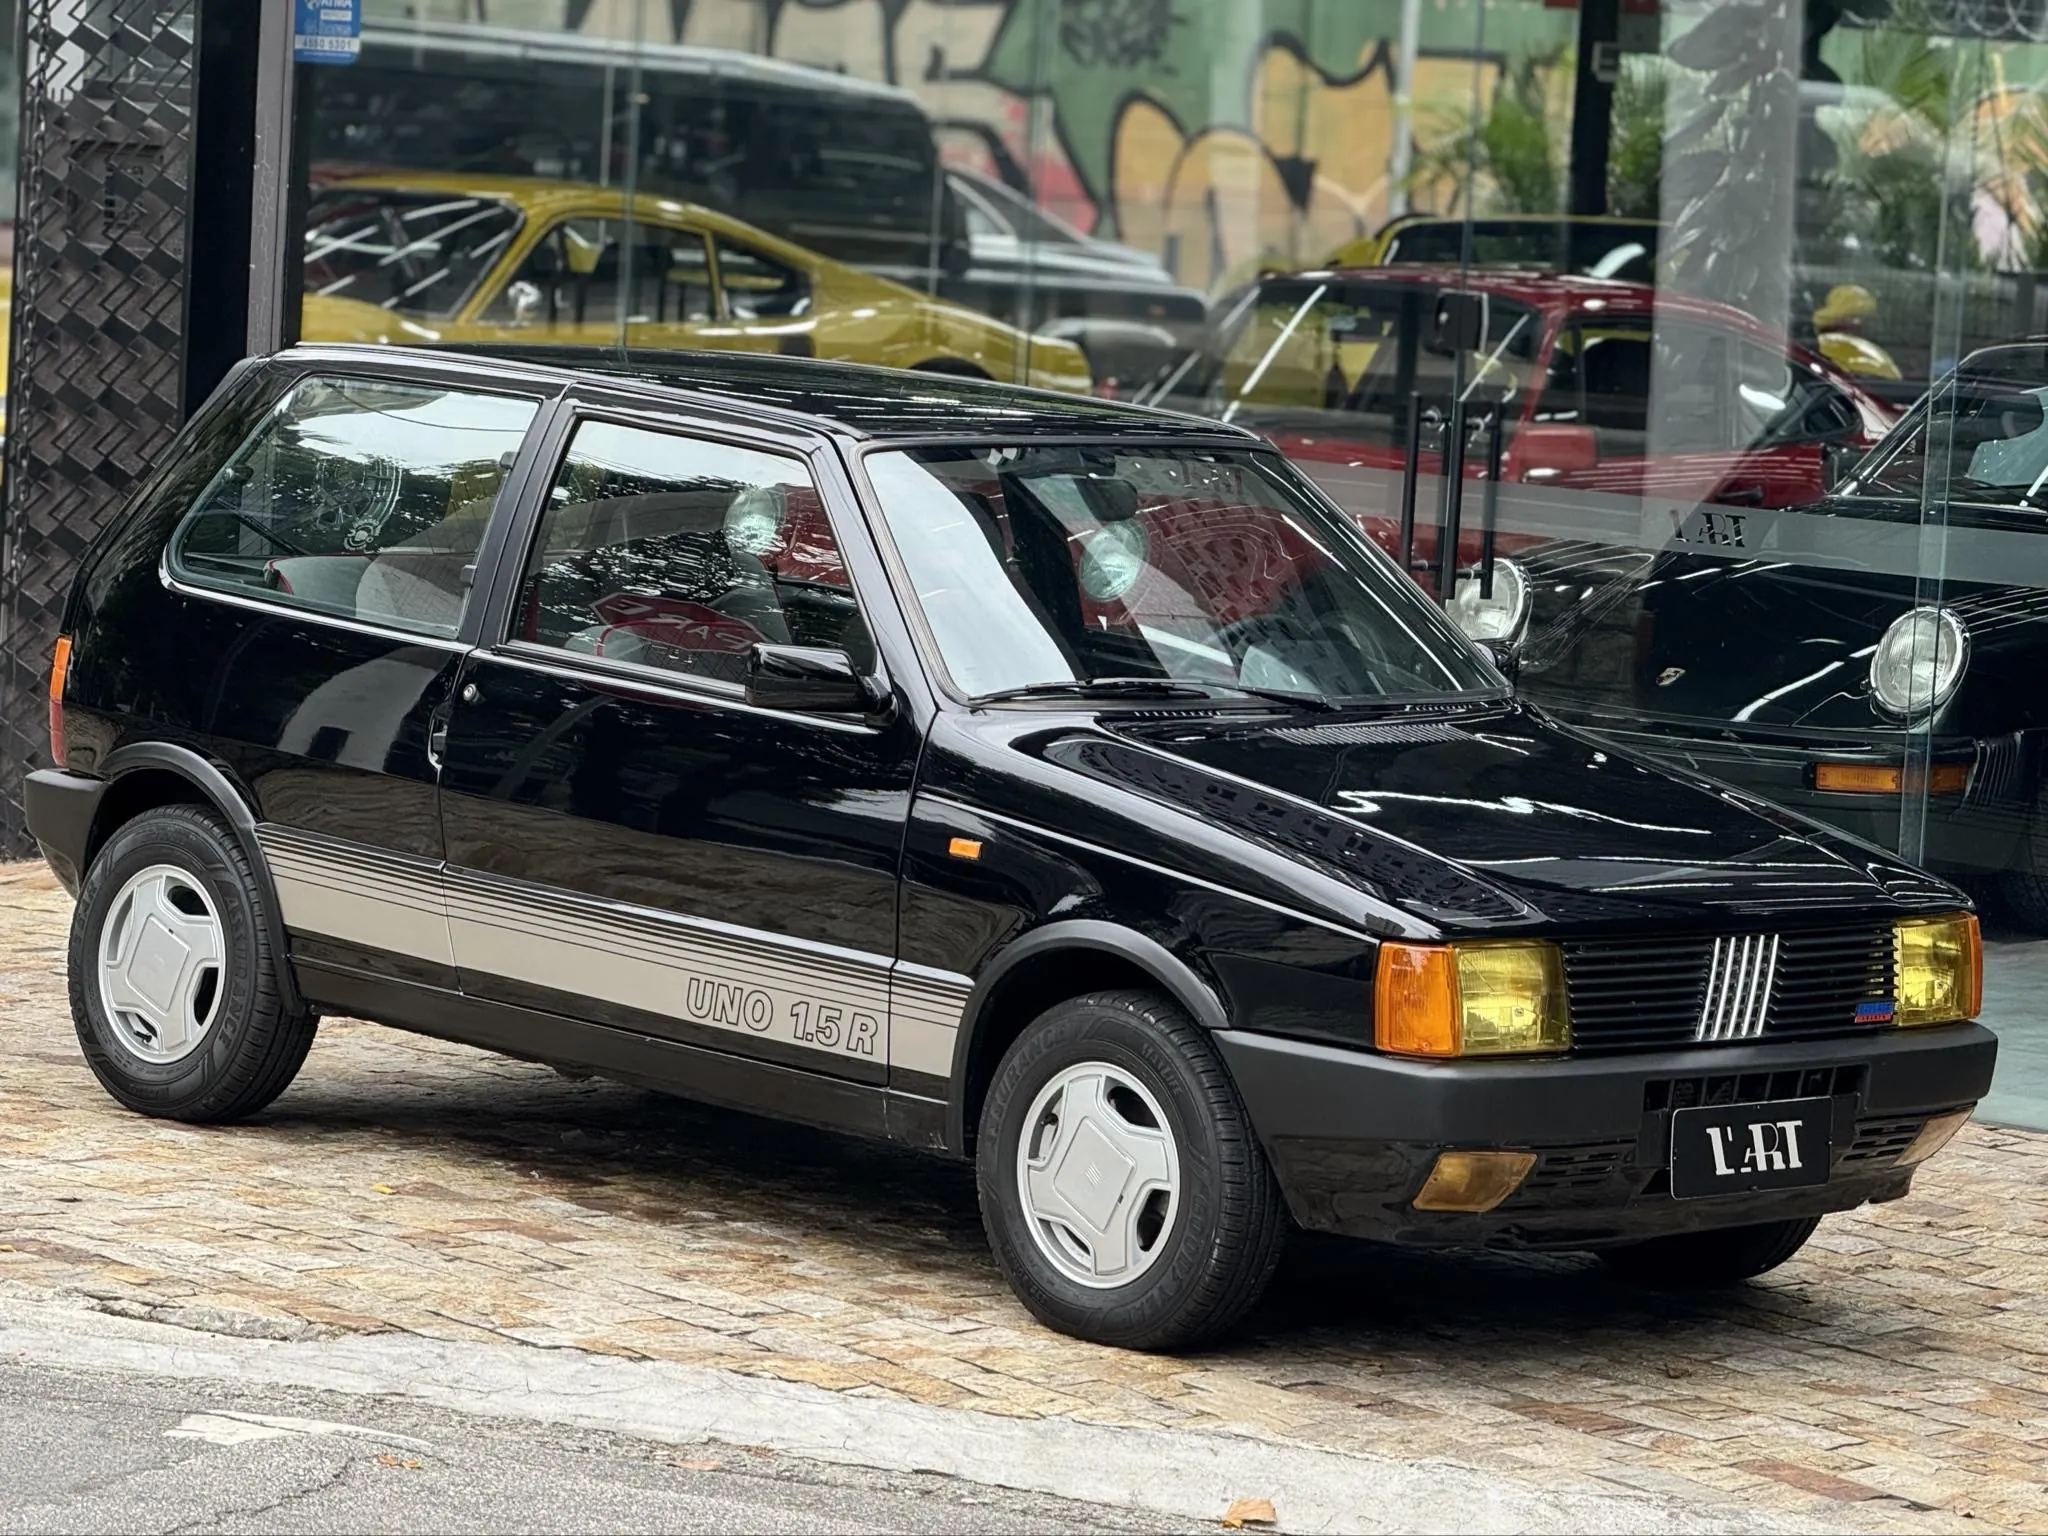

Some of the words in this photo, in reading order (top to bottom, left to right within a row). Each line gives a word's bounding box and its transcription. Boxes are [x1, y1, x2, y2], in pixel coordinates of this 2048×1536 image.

[1669, 509, 1746, 548] LART
[687, 977, 773, 1031] UNO
[791, 1001, 842, 1047] 1.5
[846, 1012, 878, 1055] R
[1706, 1120, 1802, 1175] L'ART
